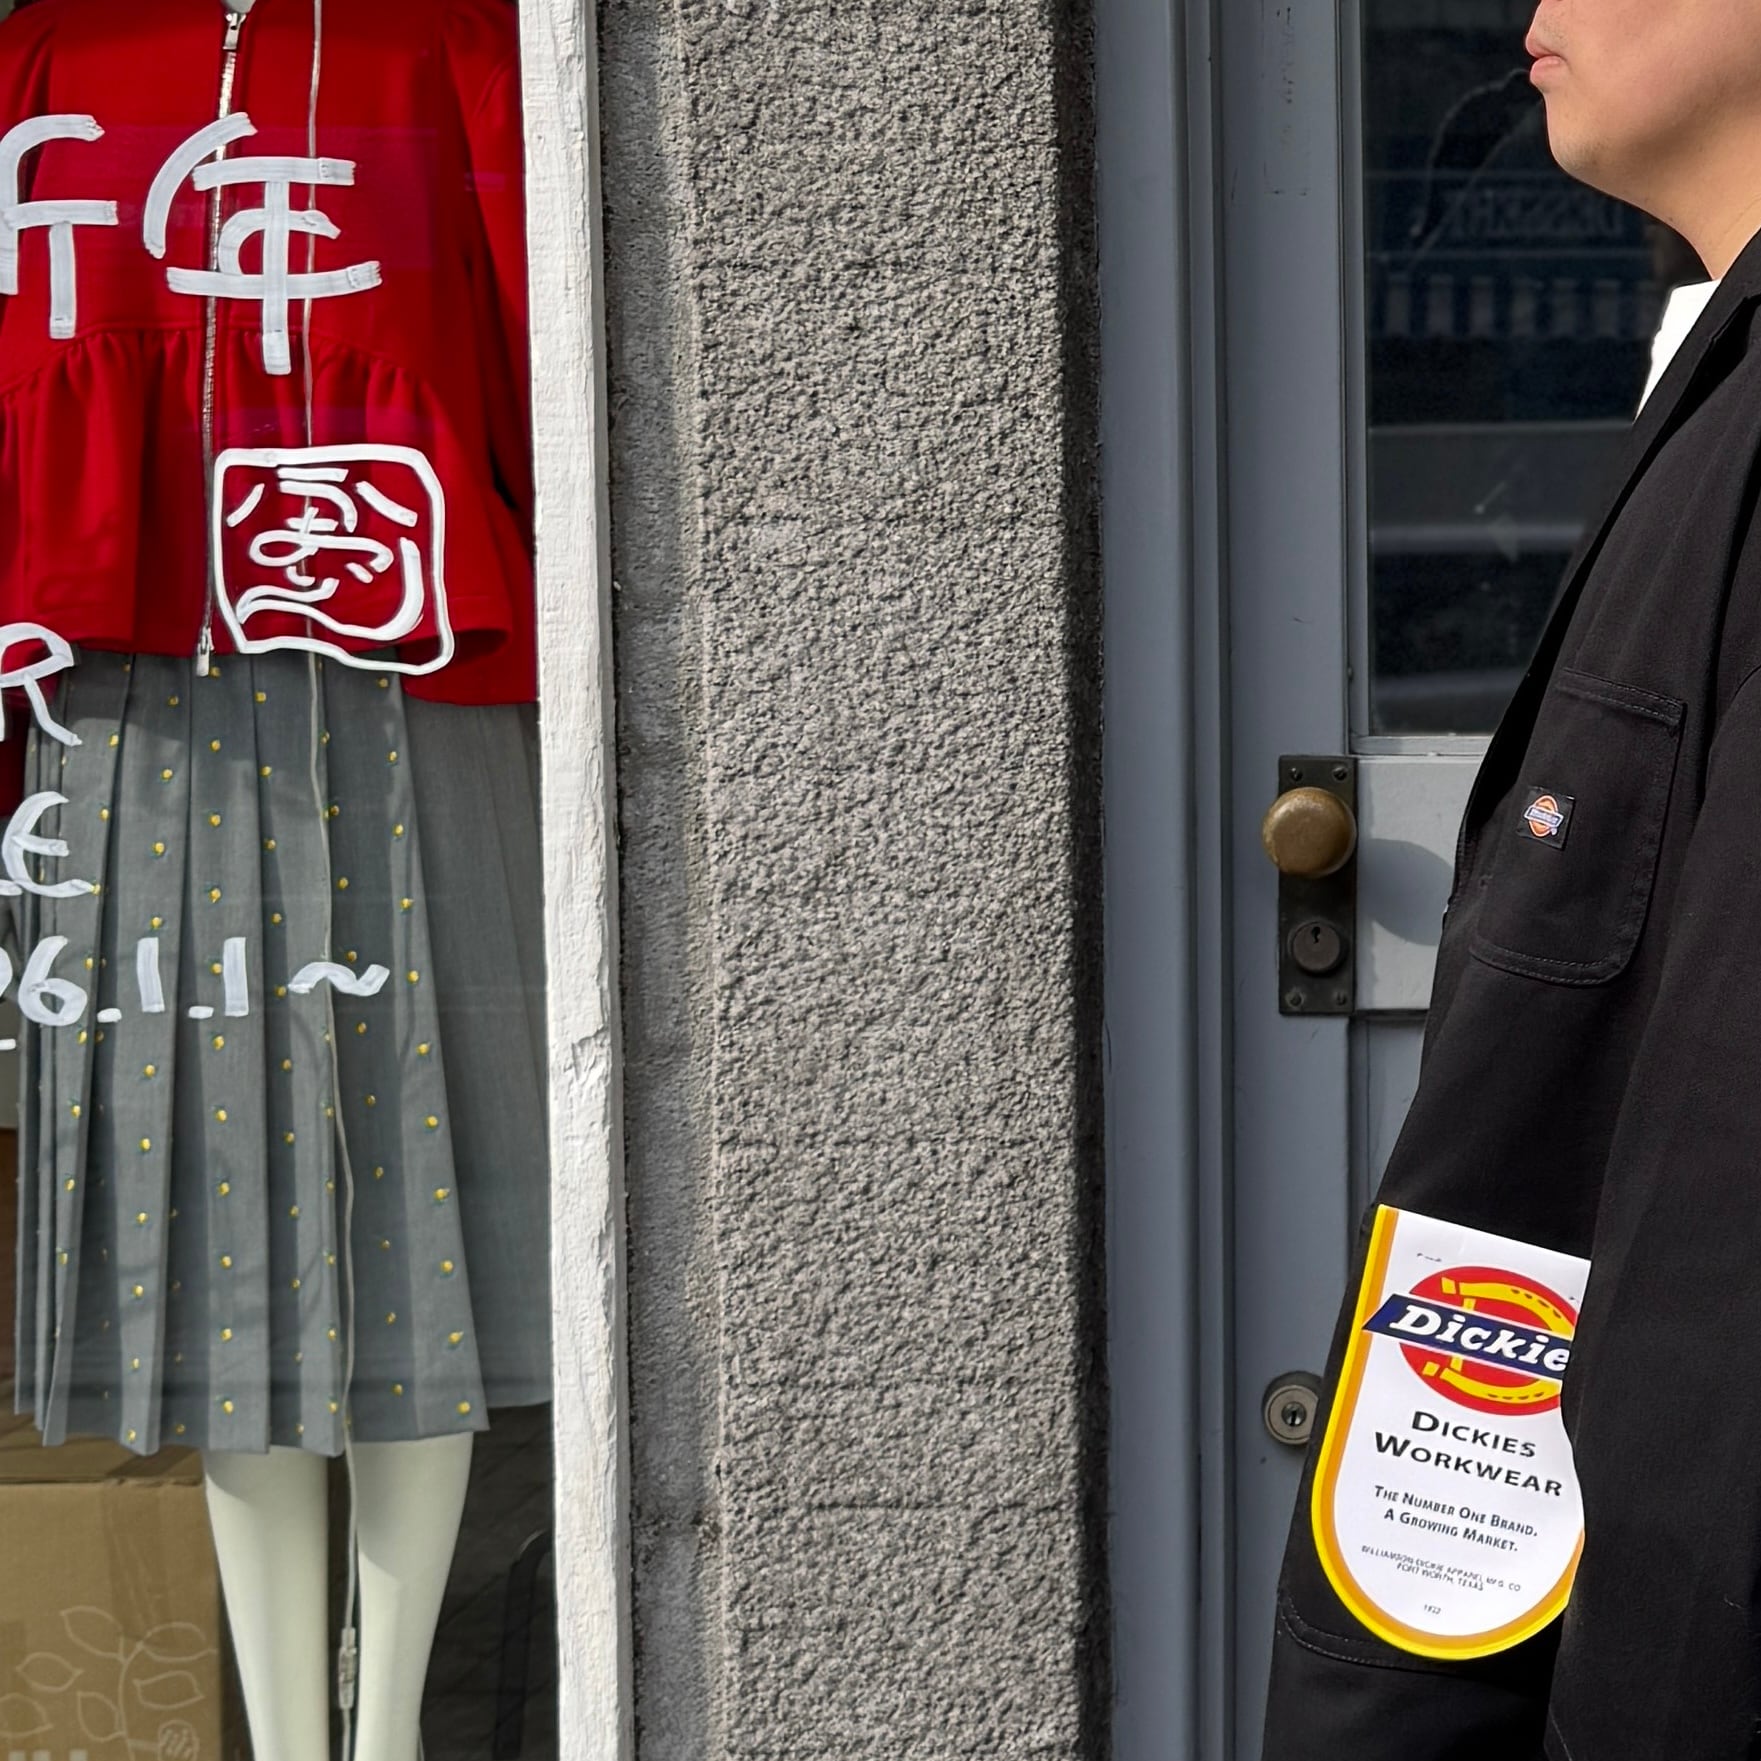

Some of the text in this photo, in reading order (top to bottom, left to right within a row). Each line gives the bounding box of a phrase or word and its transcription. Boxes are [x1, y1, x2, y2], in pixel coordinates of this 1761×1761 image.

[1411, 1410, 1537, 1458] DICKIES
[1375, 1431, 1563, 1497] WORKWEAR
[1374, 1485, 1538, 1537] THE NUMBER ONE BRAND.
[1384, 1508, 1518, 1552] A GROWING MARKET.
